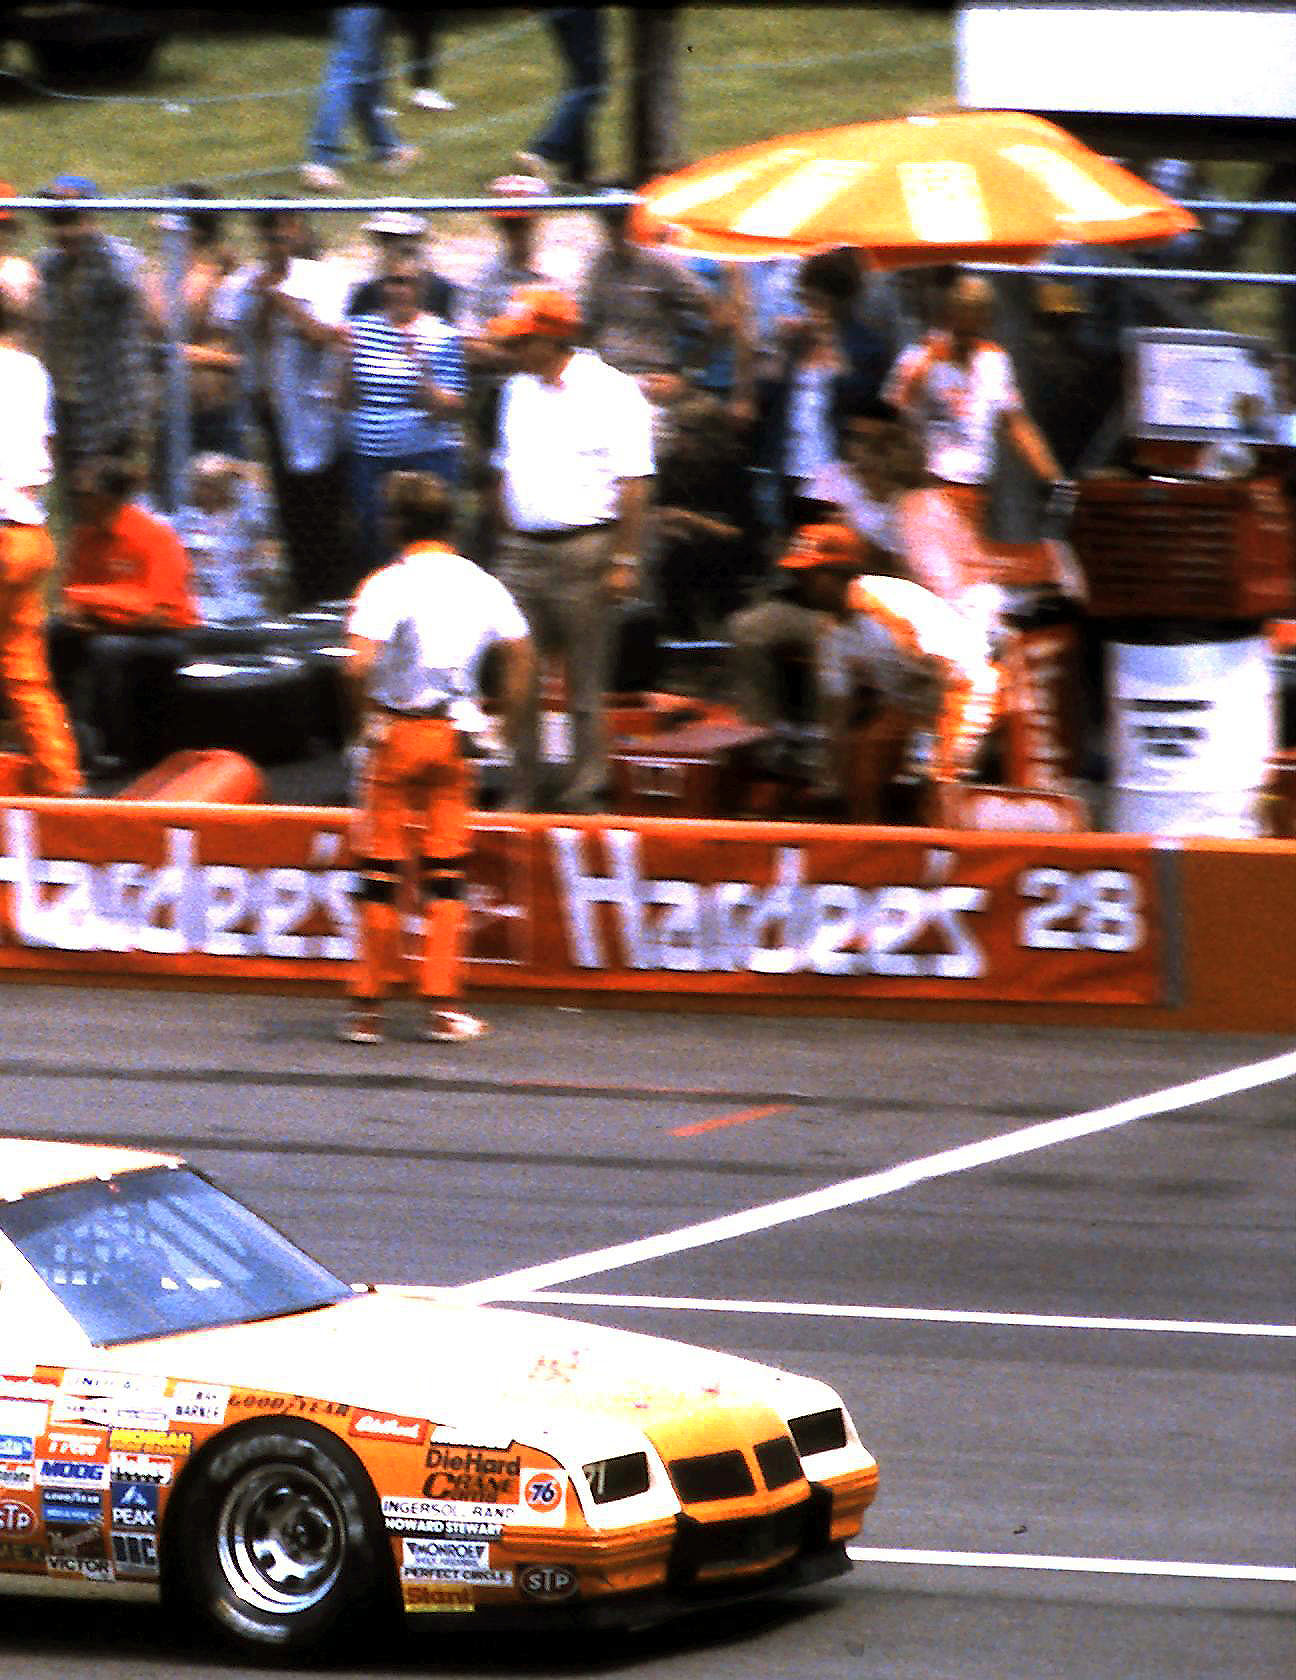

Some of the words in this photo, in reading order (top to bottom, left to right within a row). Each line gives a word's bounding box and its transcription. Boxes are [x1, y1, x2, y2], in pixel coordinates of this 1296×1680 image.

[550, 827, 990, 979] Hardee's
[1018, 867, 1146, 952] 28
[40, 1461, 104, 1481] MOOG
[425, 1448, 520, 1476] DieHard
[528, 1480, 553, 1503] 76
[112, 1508, 156, 1526] PEAK
[528, 1568, 572, 1593] STP
